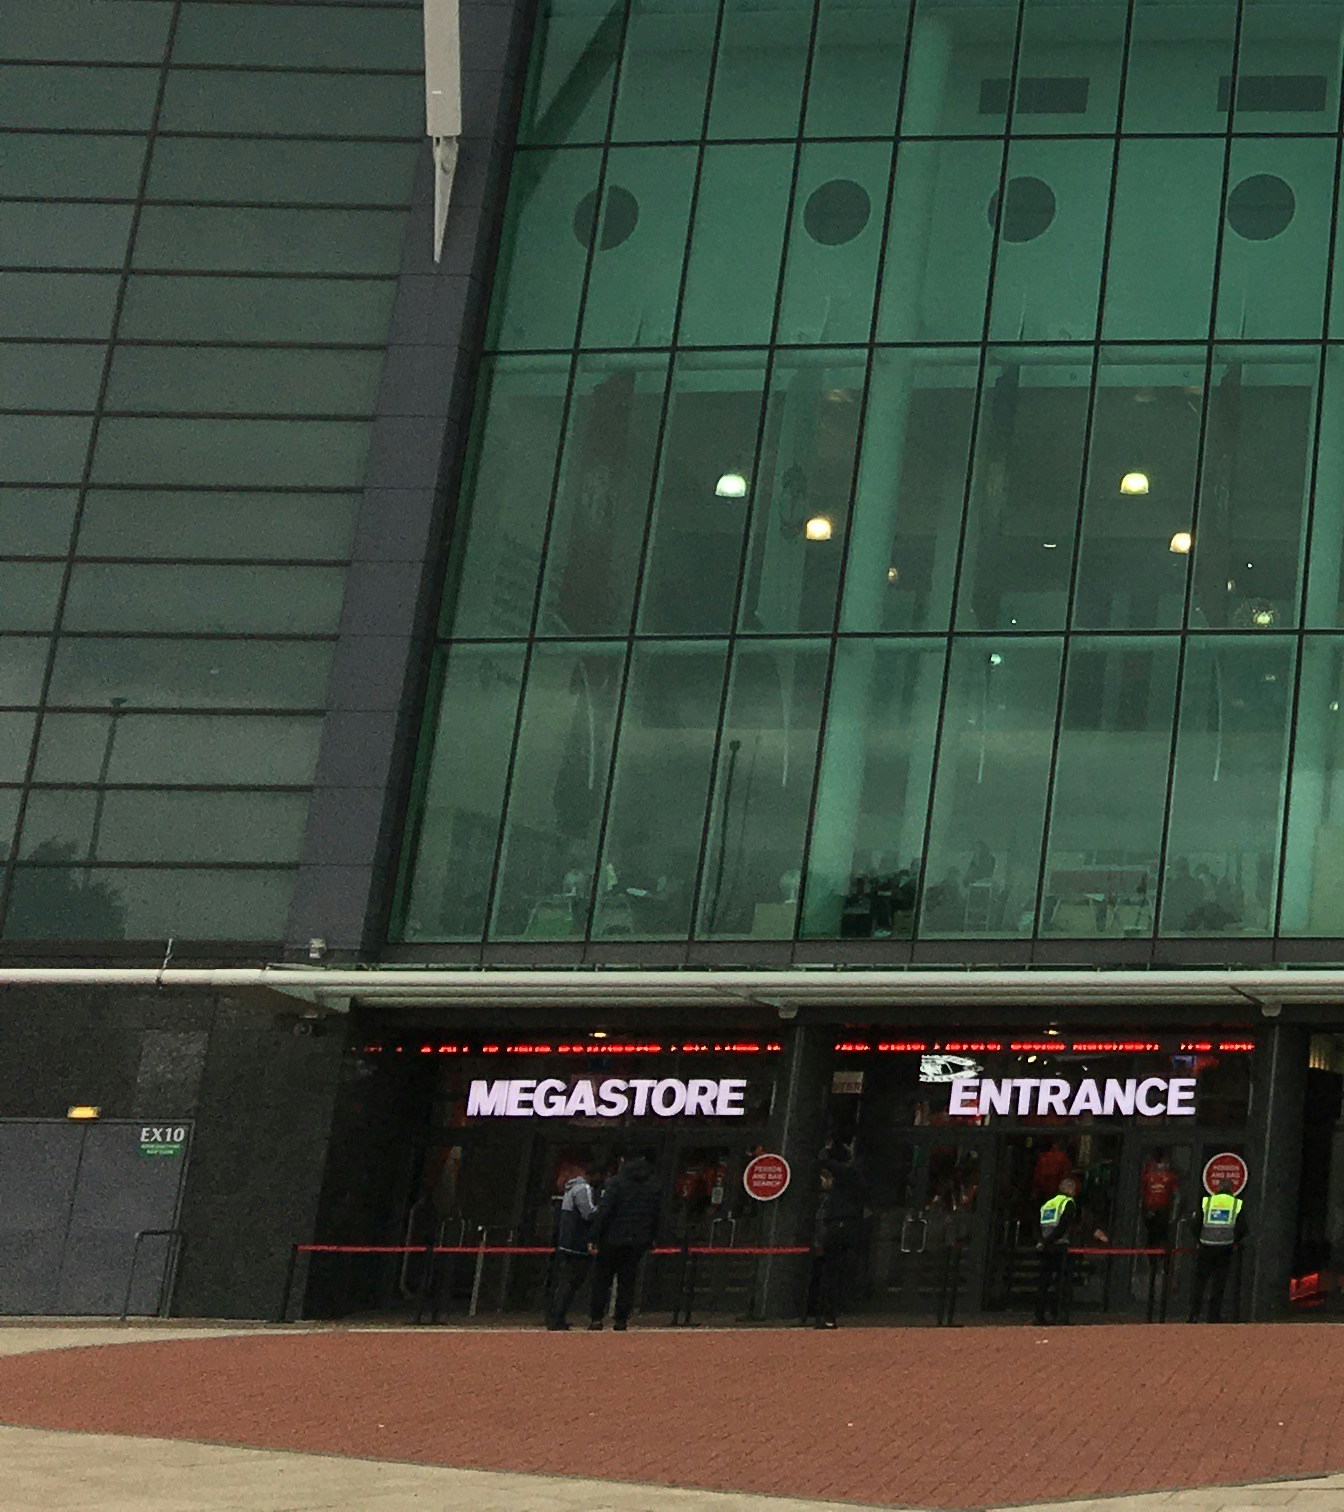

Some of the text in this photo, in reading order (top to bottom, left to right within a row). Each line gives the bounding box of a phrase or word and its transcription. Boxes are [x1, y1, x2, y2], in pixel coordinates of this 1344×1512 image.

[466, 1078, 748, 1117] MEGASTORE
[948, 1077, 1197, 1116] ENTRANCE
[139, 1127, 186, 1143] EX10
